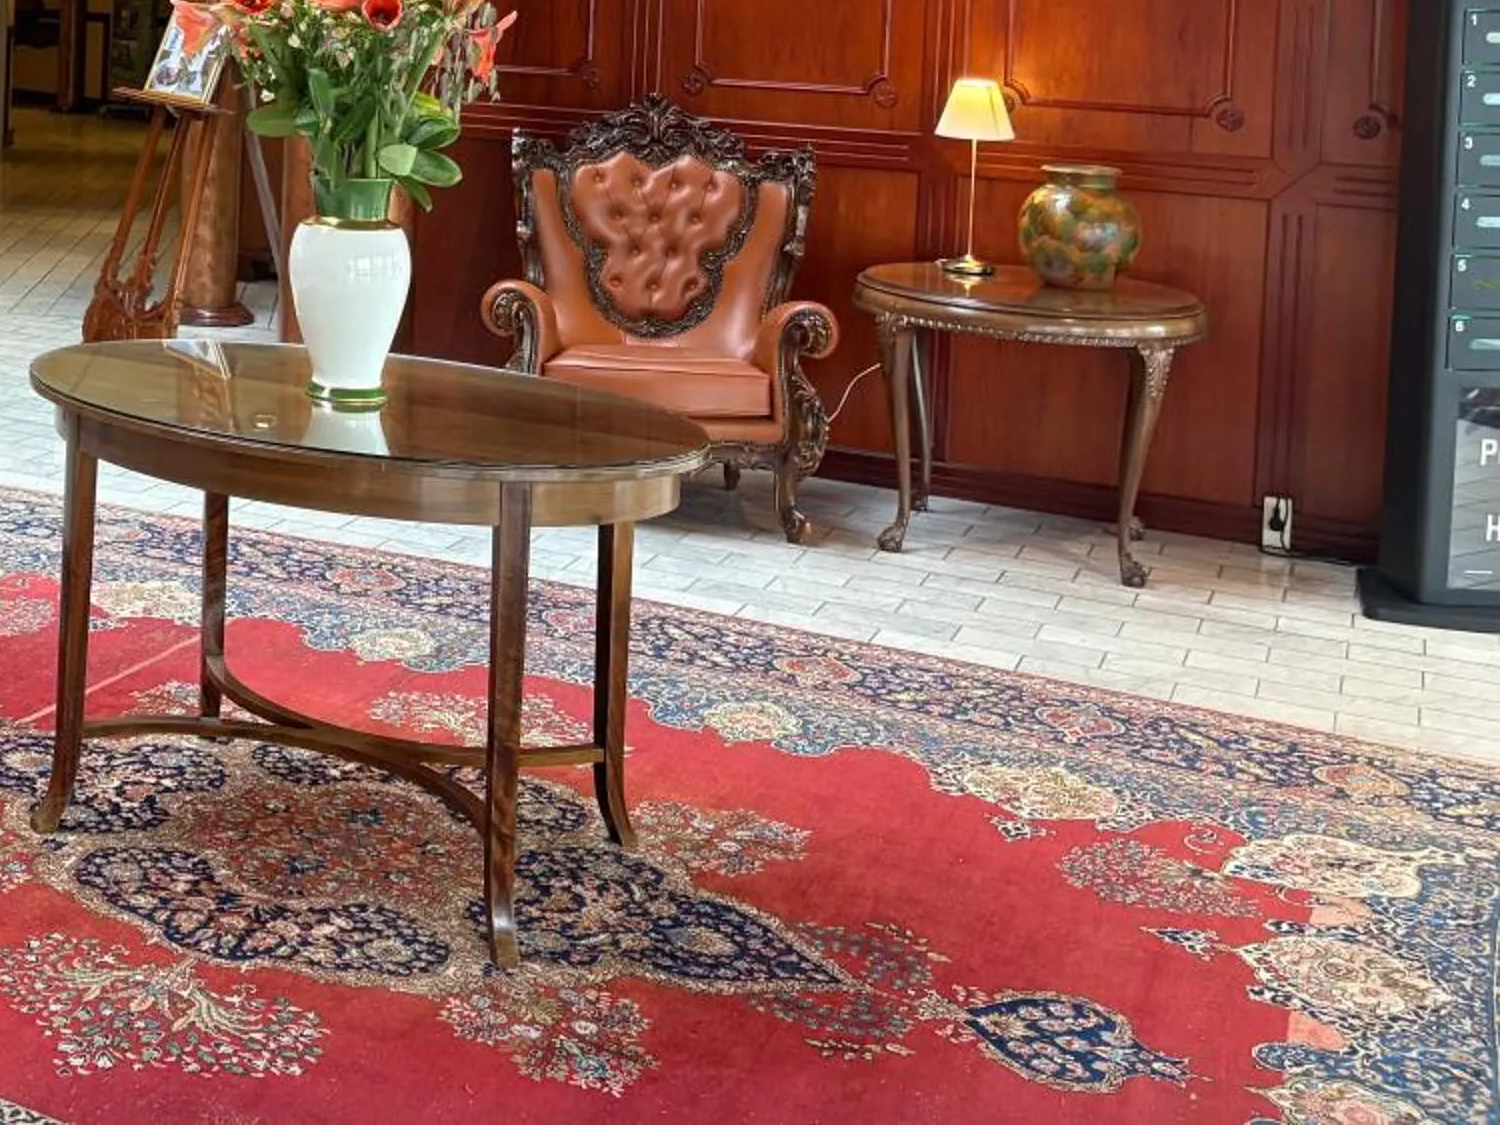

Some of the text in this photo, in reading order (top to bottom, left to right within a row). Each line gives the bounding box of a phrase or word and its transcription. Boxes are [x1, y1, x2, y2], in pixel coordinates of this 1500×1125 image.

[1471, 13, 1478, 26] 1
[1467, 75, 1477, 88] 2
[1464, 136, 1474, 150] 3
[1461, 197, 1471, 210] 4
[1457, 258, 1467, 272] 5
[1479, 438, 1500, 467] P
